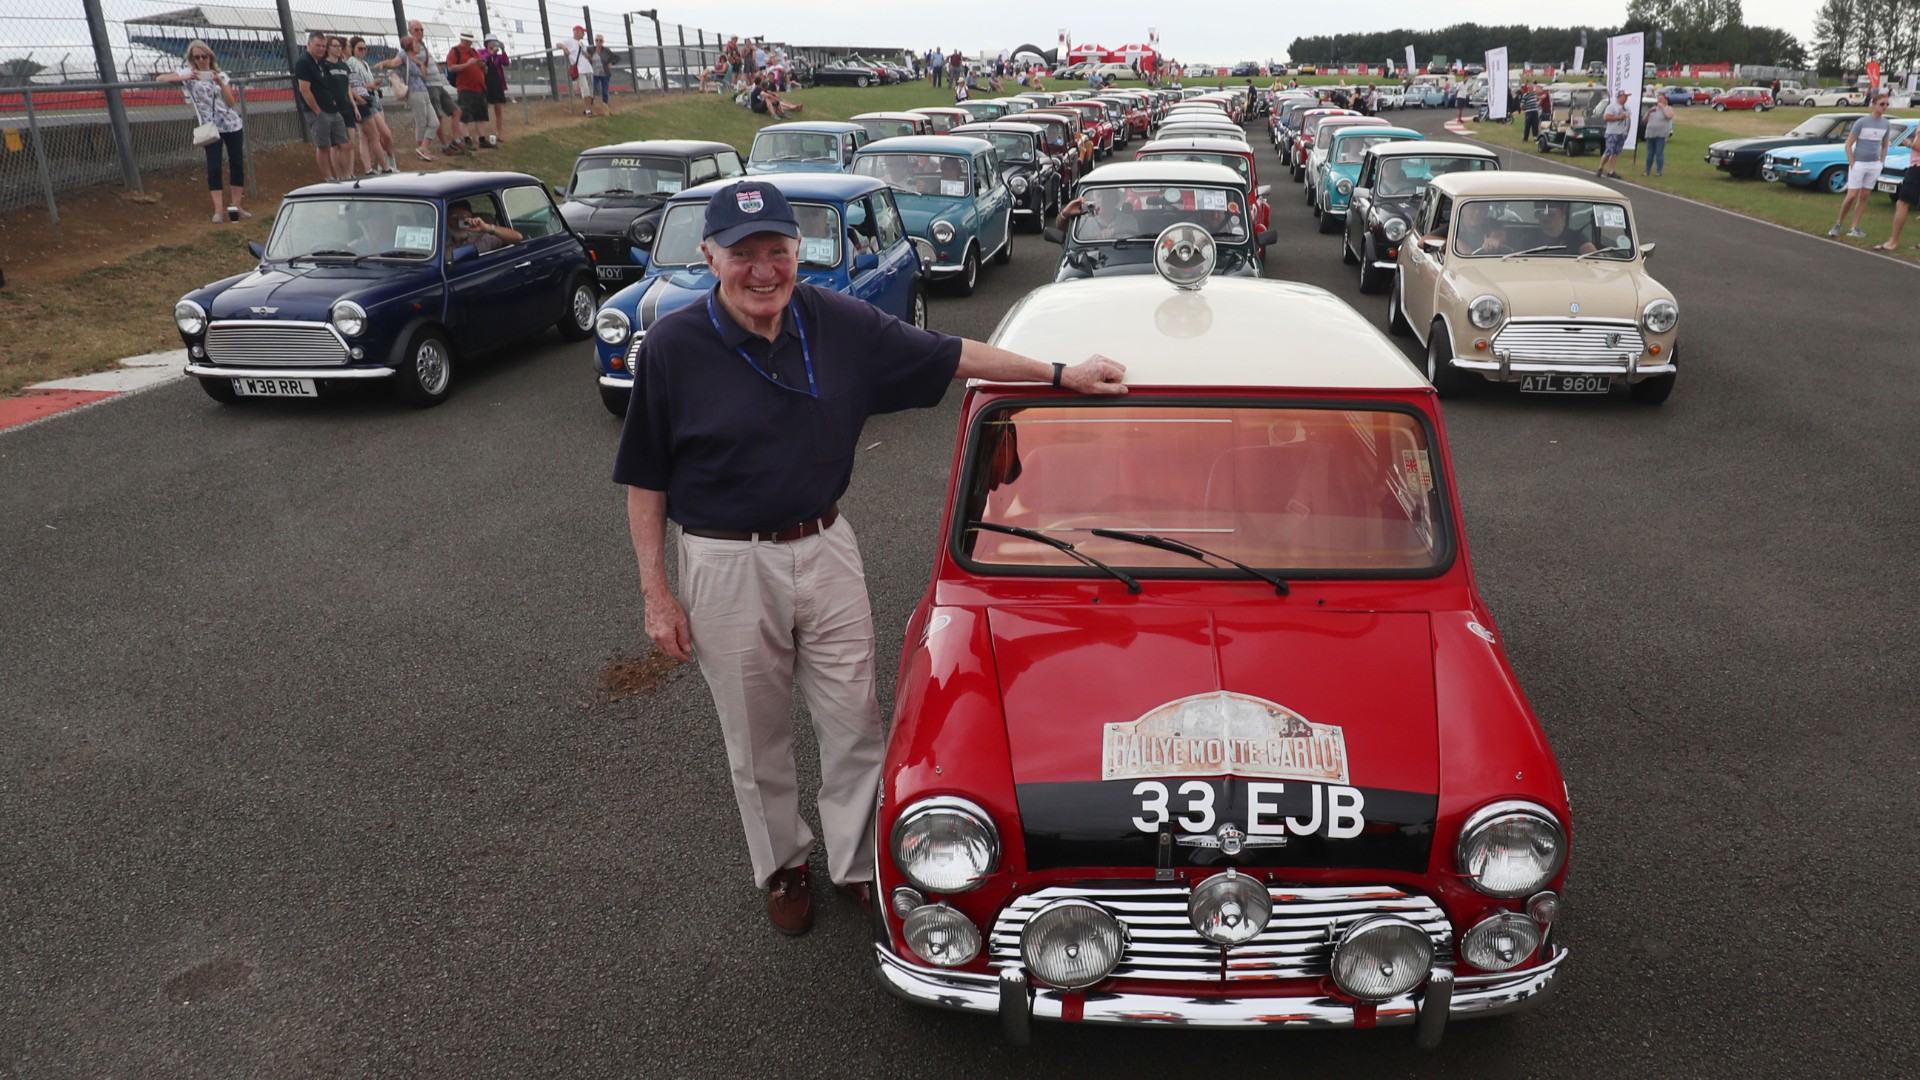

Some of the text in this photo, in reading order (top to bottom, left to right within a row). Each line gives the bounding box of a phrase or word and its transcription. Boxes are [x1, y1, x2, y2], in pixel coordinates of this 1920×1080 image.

[246, 380, 310, 395] W38 RRL
[1522, 376, 1607, 391] ATL 960L
[1113, 731, 1185, 768] RALLYE
[1131, 780, 1366, 839] 33 EJB
